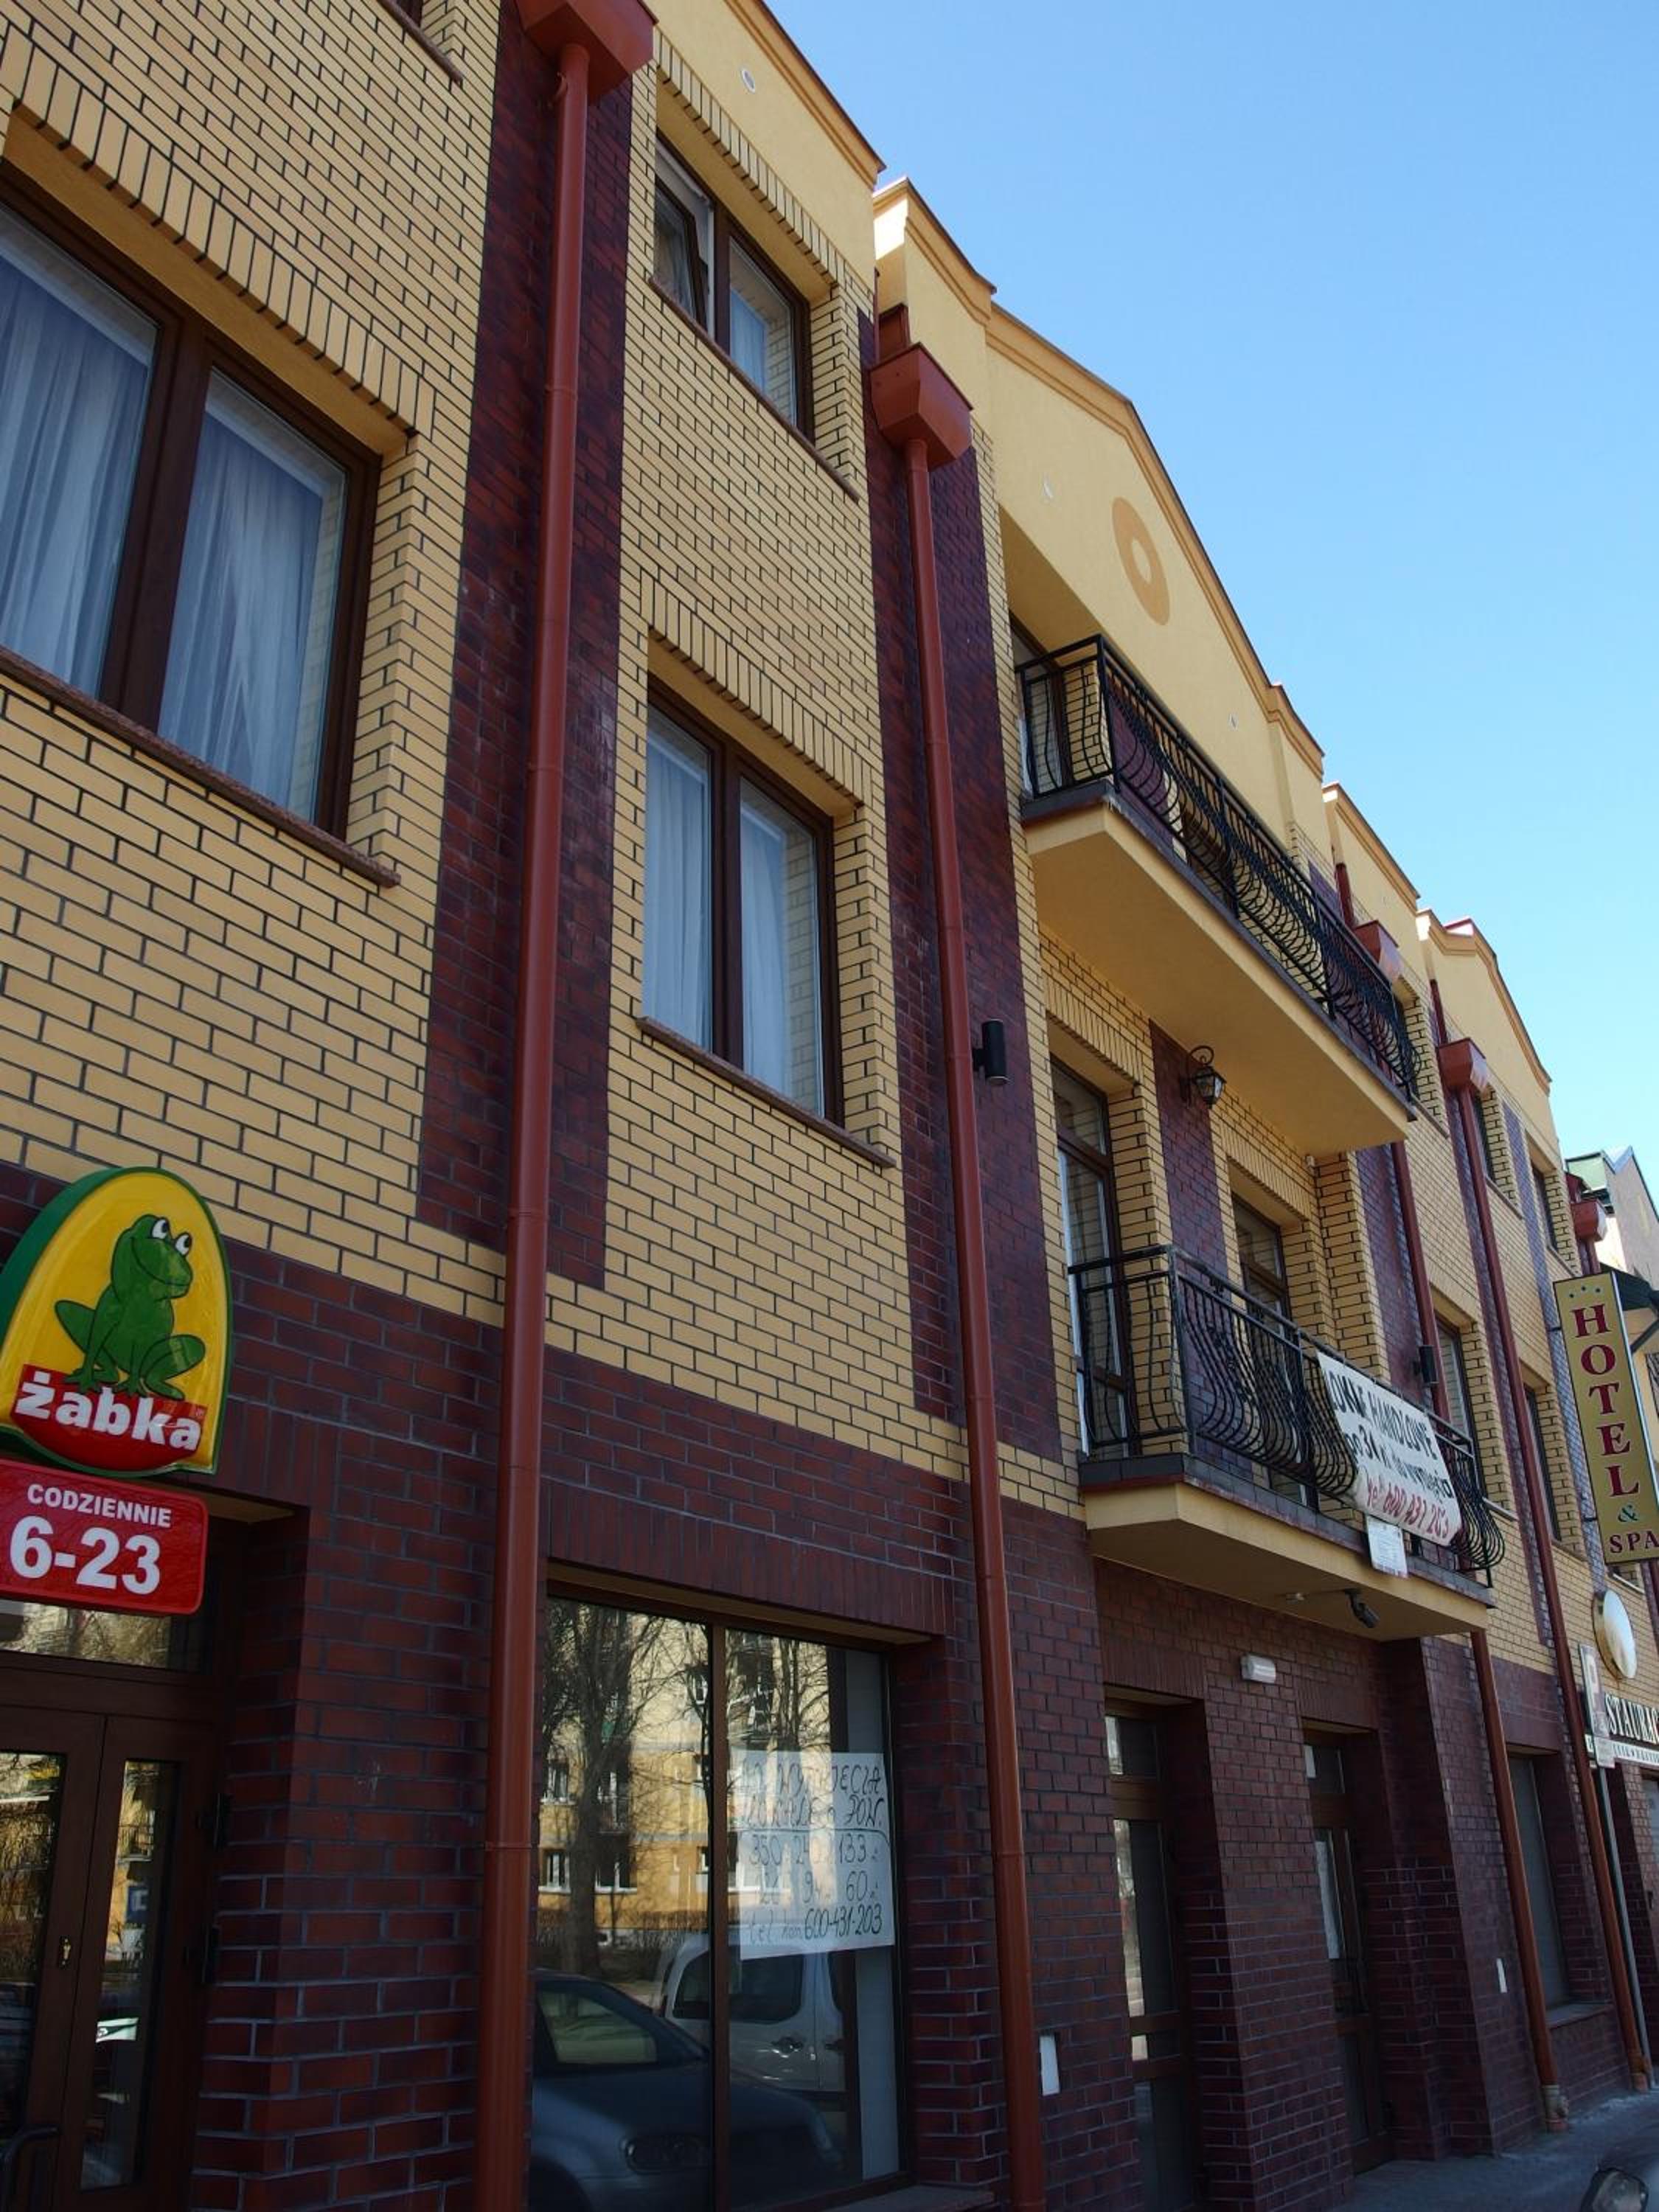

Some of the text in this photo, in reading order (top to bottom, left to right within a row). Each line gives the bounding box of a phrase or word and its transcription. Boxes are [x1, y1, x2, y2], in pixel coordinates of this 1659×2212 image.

[15, 1371, 203, 1451] żabka
[1571, 1304, 1639, 1498] HOTEL
[27, 1483, 172, 1528] CODZIENNIE
[1618, 1504, 1640, 1524] &
[10, 1514, 161, 1596] 6-23
[1609, 1529, 1659, 1554] SPA
